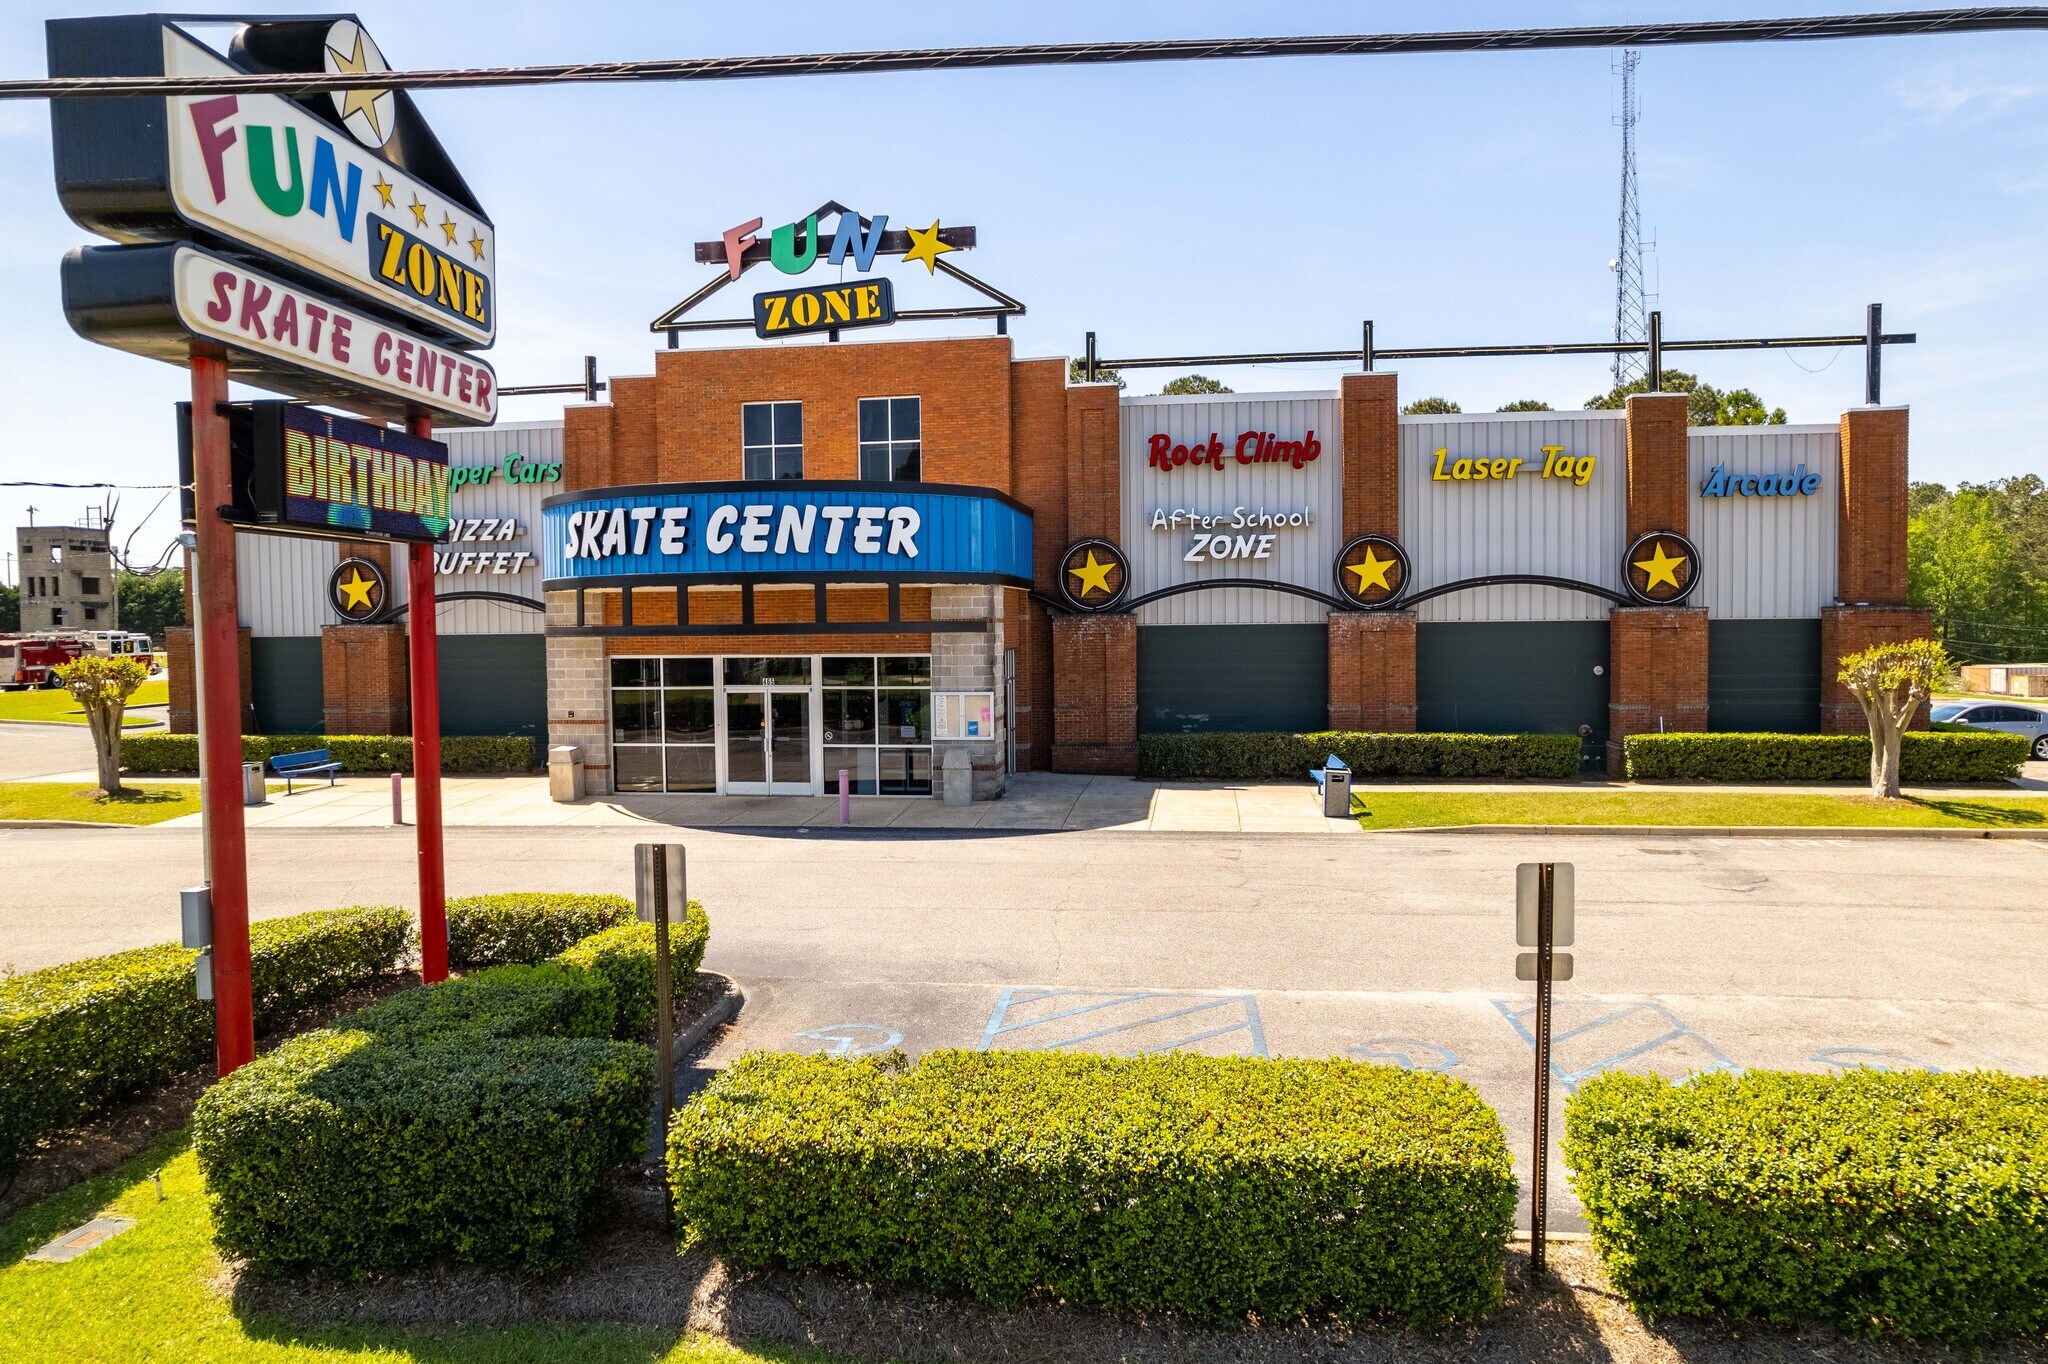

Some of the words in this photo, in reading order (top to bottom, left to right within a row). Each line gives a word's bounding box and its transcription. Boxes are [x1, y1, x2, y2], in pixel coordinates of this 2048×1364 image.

[188, 95, 363, 243] FUN
[722, 211, 890, 282] FUN
[378, 224, 486, 323] ZONE
[763, 285, 881, 331] ZONE
[206, 272, 353, 364] SKATE
[374, 331, 493, 413] CENTER
[284, 427, 449, 519] BIRTHDAY
[448, 465, 496, 493] per
[503, 453, 562, 485] Cars
[1148, 433, 1225, 472] Rock
[1235, 430, 1321, 470] Climb
[1432, 447, 1523, 481] Laser
[1540, 445, 1598, 486] Tag
[1701, 460, 1822, 498] Arcade
[565, 506, 691, 561] SKATE
[706, 504, 922, 559] CENTER
[1151, 507, 1223, 531] After
[1231, 505, 1309, 530] School
[1183, 533, 1277, 562] ZONE
